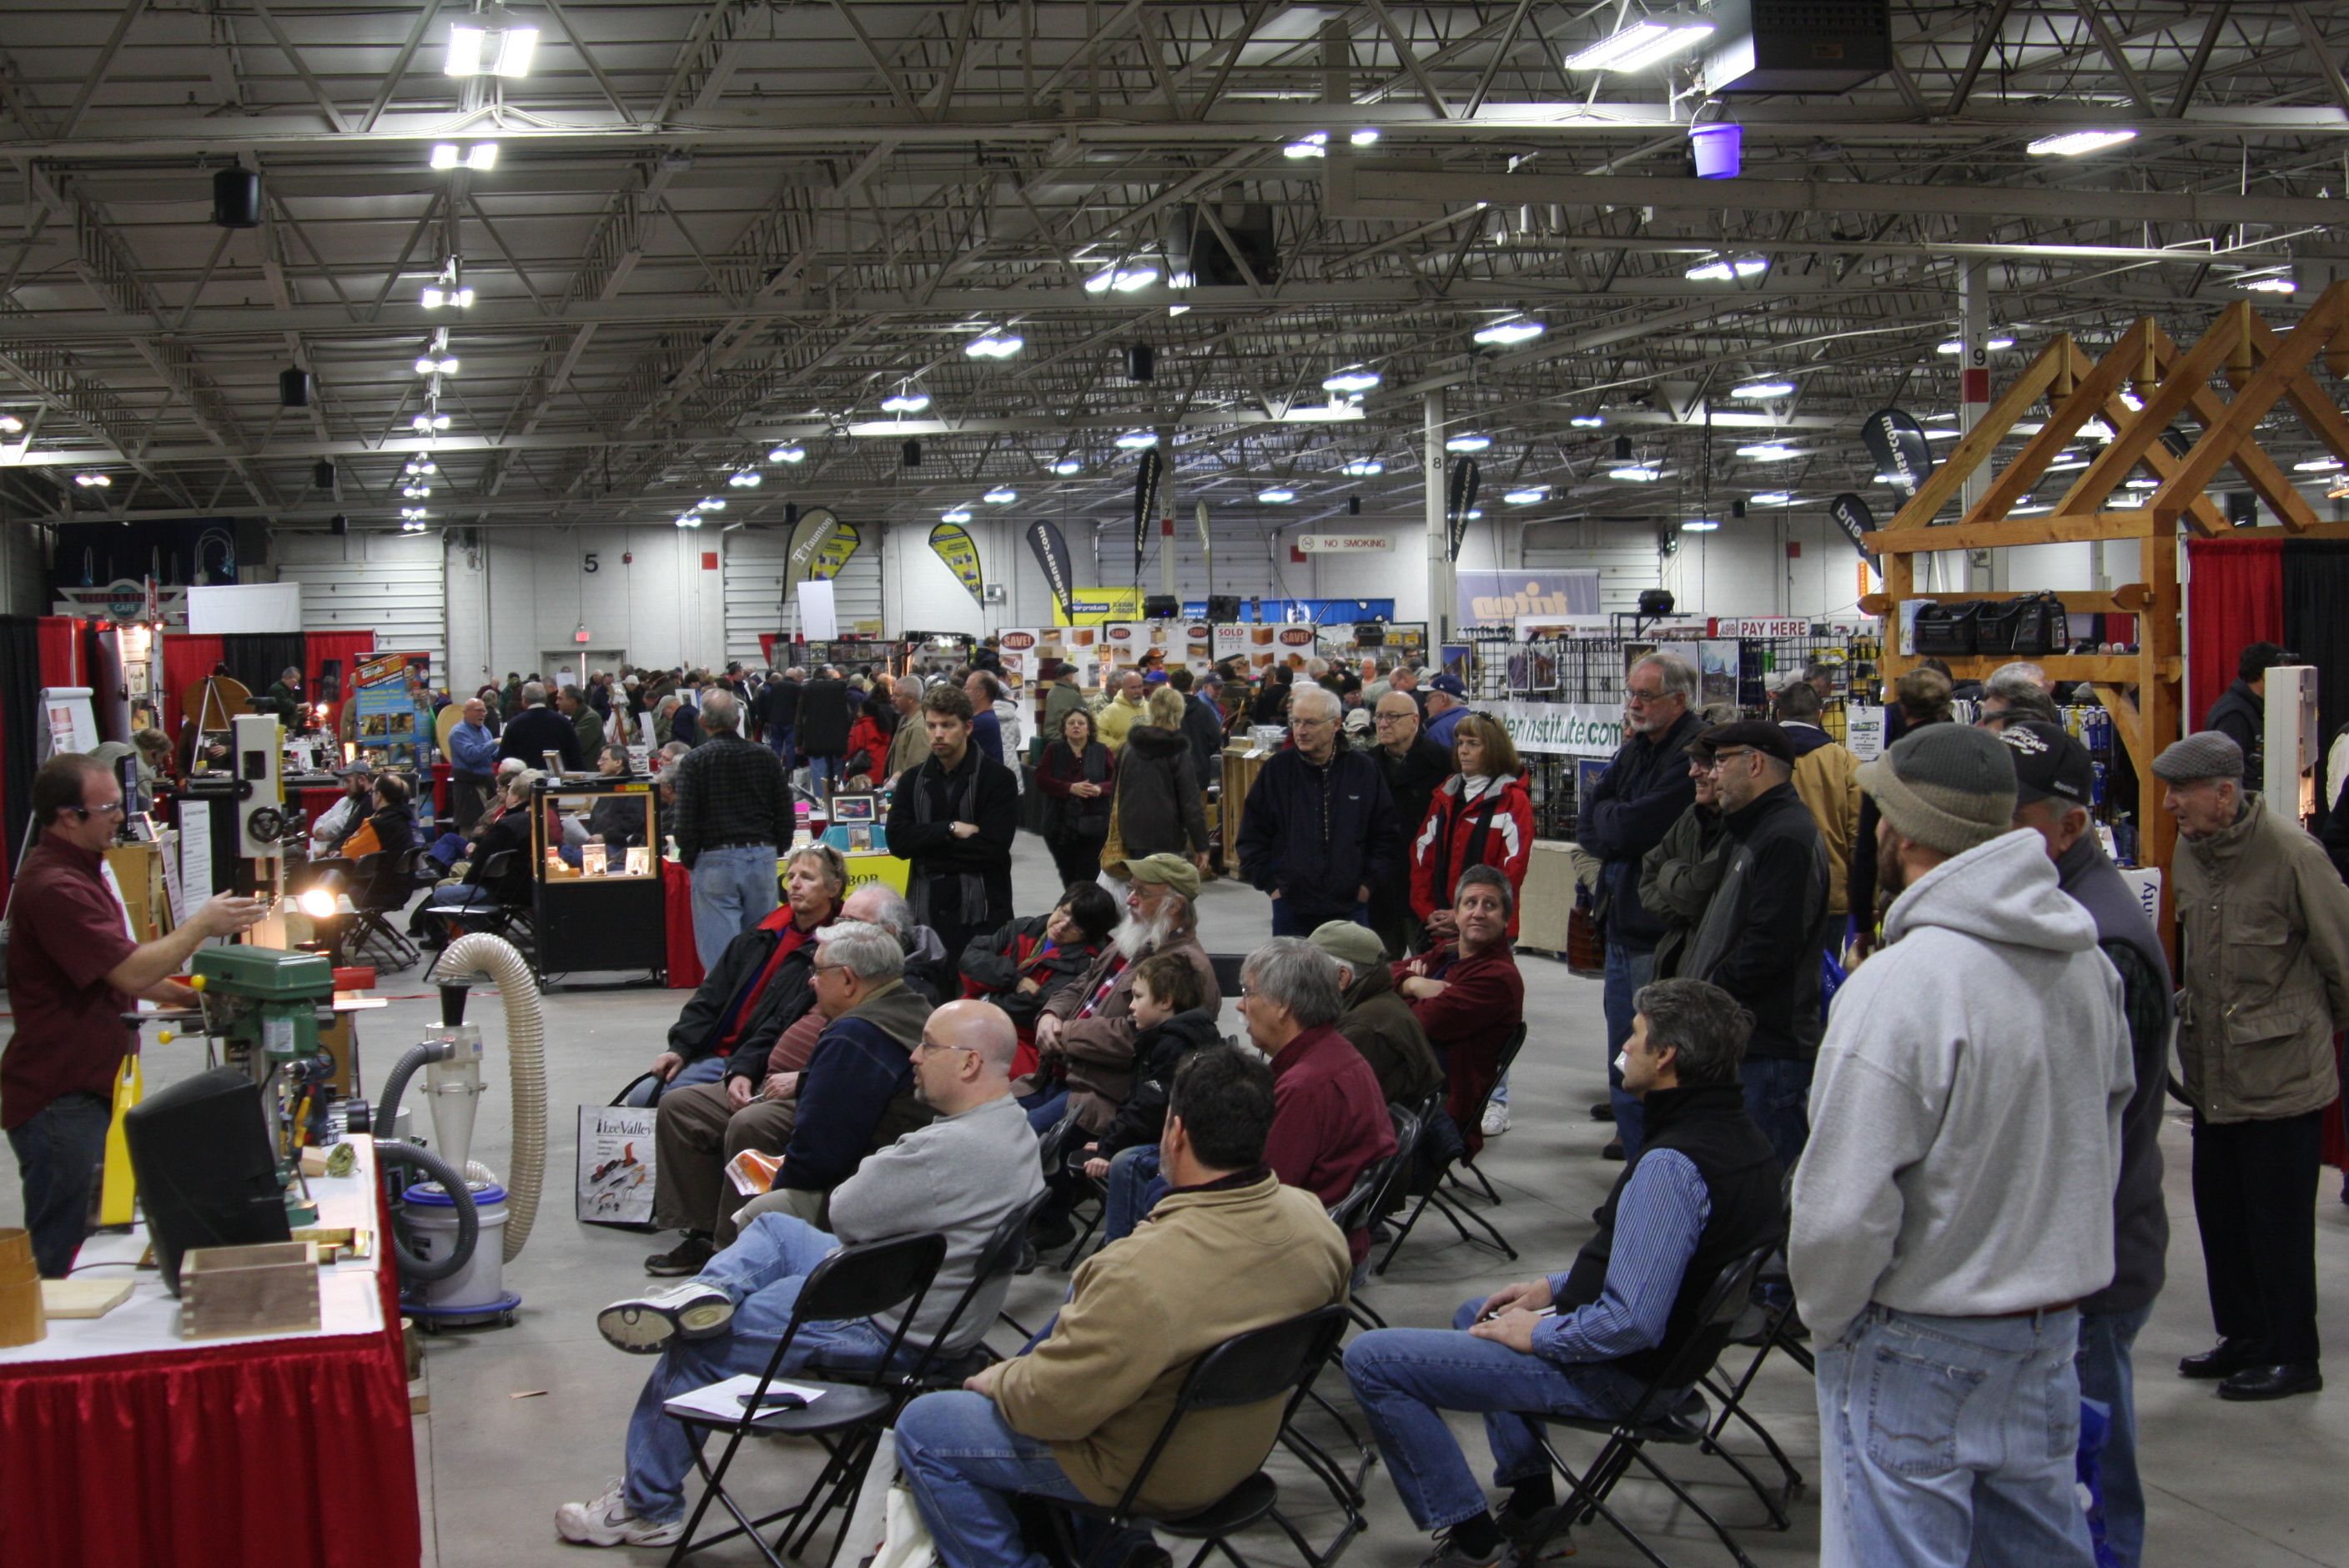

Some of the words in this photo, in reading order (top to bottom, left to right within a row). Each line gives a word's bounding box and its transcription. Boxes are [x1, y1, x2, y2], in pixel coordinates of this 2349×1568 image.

[1974, 348, 1986, 366] 9
[1433, 457, 1441, 470] 8
[802, 517, 833, 551] Taunton
[1324, 540, 1338, 548] NO
[1343, 539, 1386, 548] SMOKING
[584, 553, 599, 573] 5
[113, 604, 135, 612] CAFE
[1218, 628, 1244, 636] SOLD
[1741, 621, 1765, 636] PAY
[1770, 621, 1806, 636] HERE
[1003, 635, 1032, 647] SAVE!
[1281, 631, 1310, 643] SAVE!
[1503, 711, 1624, 746] terinstitute.com
